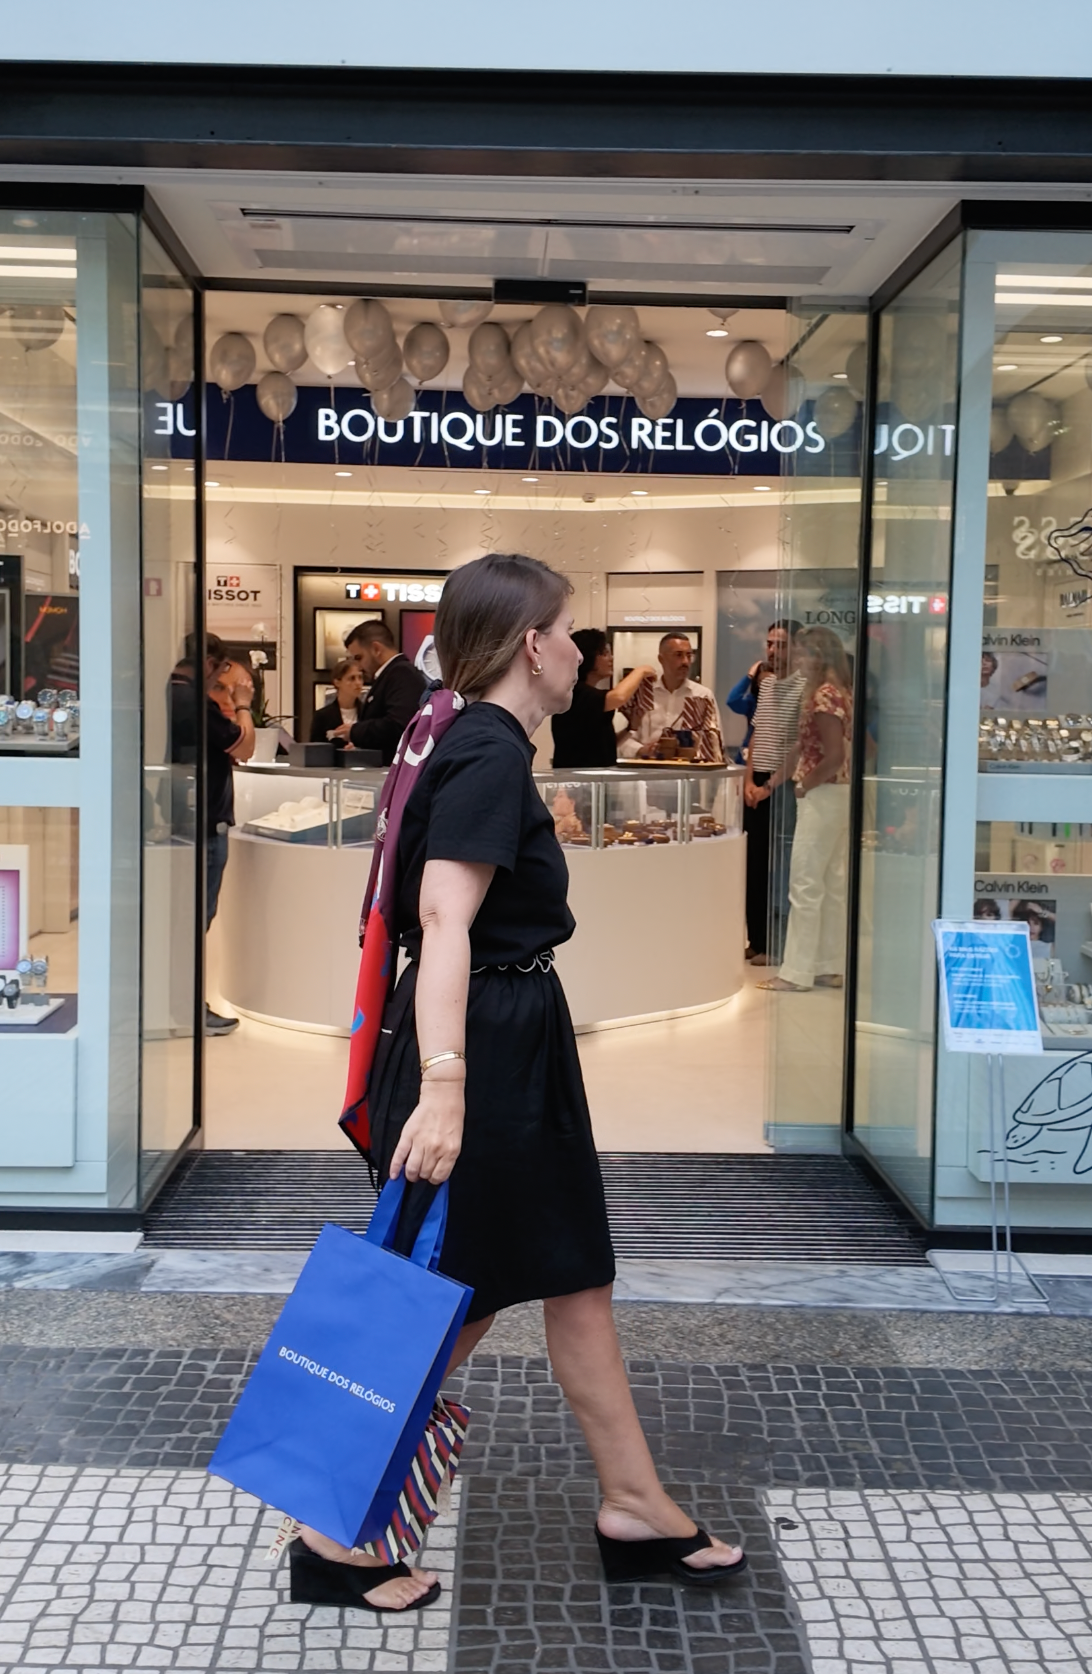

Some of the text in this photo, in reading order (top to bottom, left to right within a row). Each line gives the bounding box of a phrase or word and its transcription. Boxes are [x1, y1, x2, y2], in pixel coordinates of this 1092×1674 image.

[317, 408, 826, 453] BOUTIQUE DOS RELÓGIOS
[208, 589, 261, 601] ISSOT
[382, 583, 442, 602] TISS
[1010, 633, 1041, 647] Klein
[974, 880, 1049, 894] Calvin Klein
[279, 1346, 396, 1413] BOUTIQUE DOS RELÓGIOS
